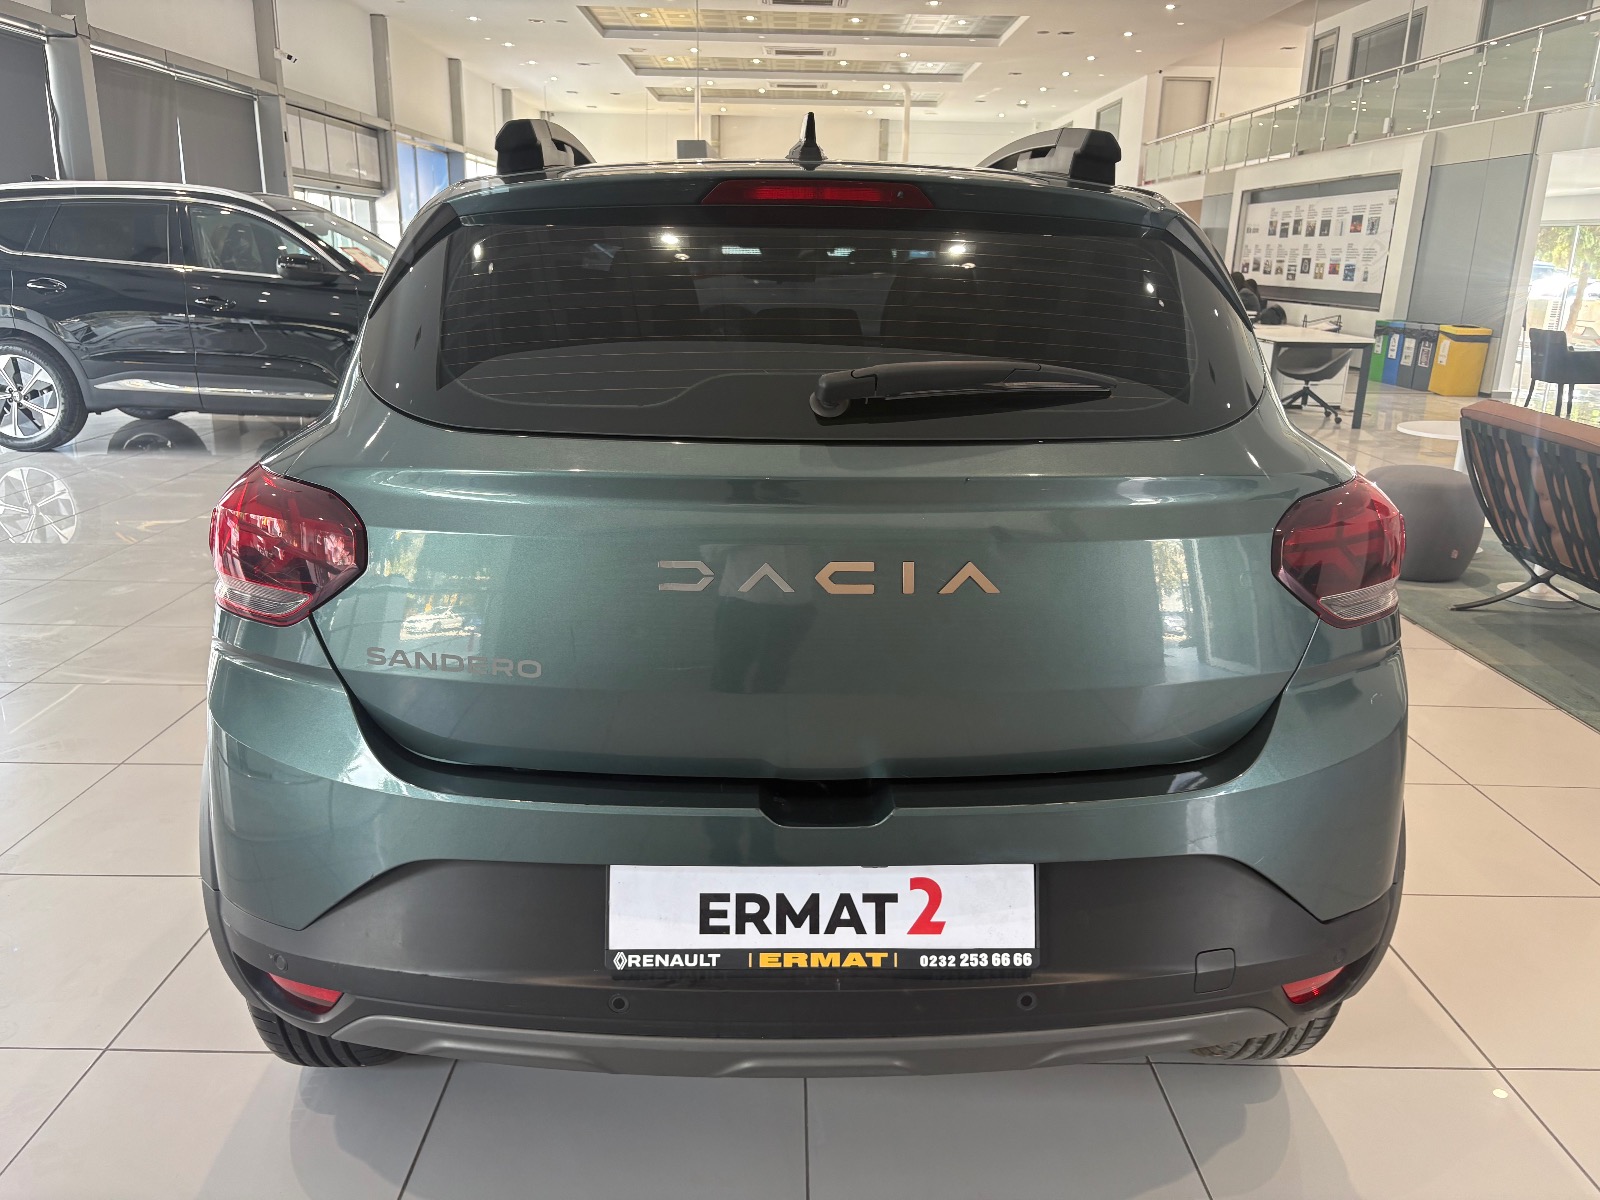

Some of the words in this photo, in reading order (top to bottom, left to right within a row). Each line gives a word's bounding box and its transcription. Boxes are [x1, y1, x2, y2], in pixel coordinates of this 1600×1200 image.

[657, 560, 1000, 595] DACIA
[366, 646, 542, 679] SANDERO
[699, 892, 899, 935] ERMAT
[907, 877, 946, 935] 2
[627, 953, 721, 968] RENAULT
[759, 952, 889, 968] ERMAT
[919, 955, 956, 967] 0232
[959, 953, 989, 966] 253
